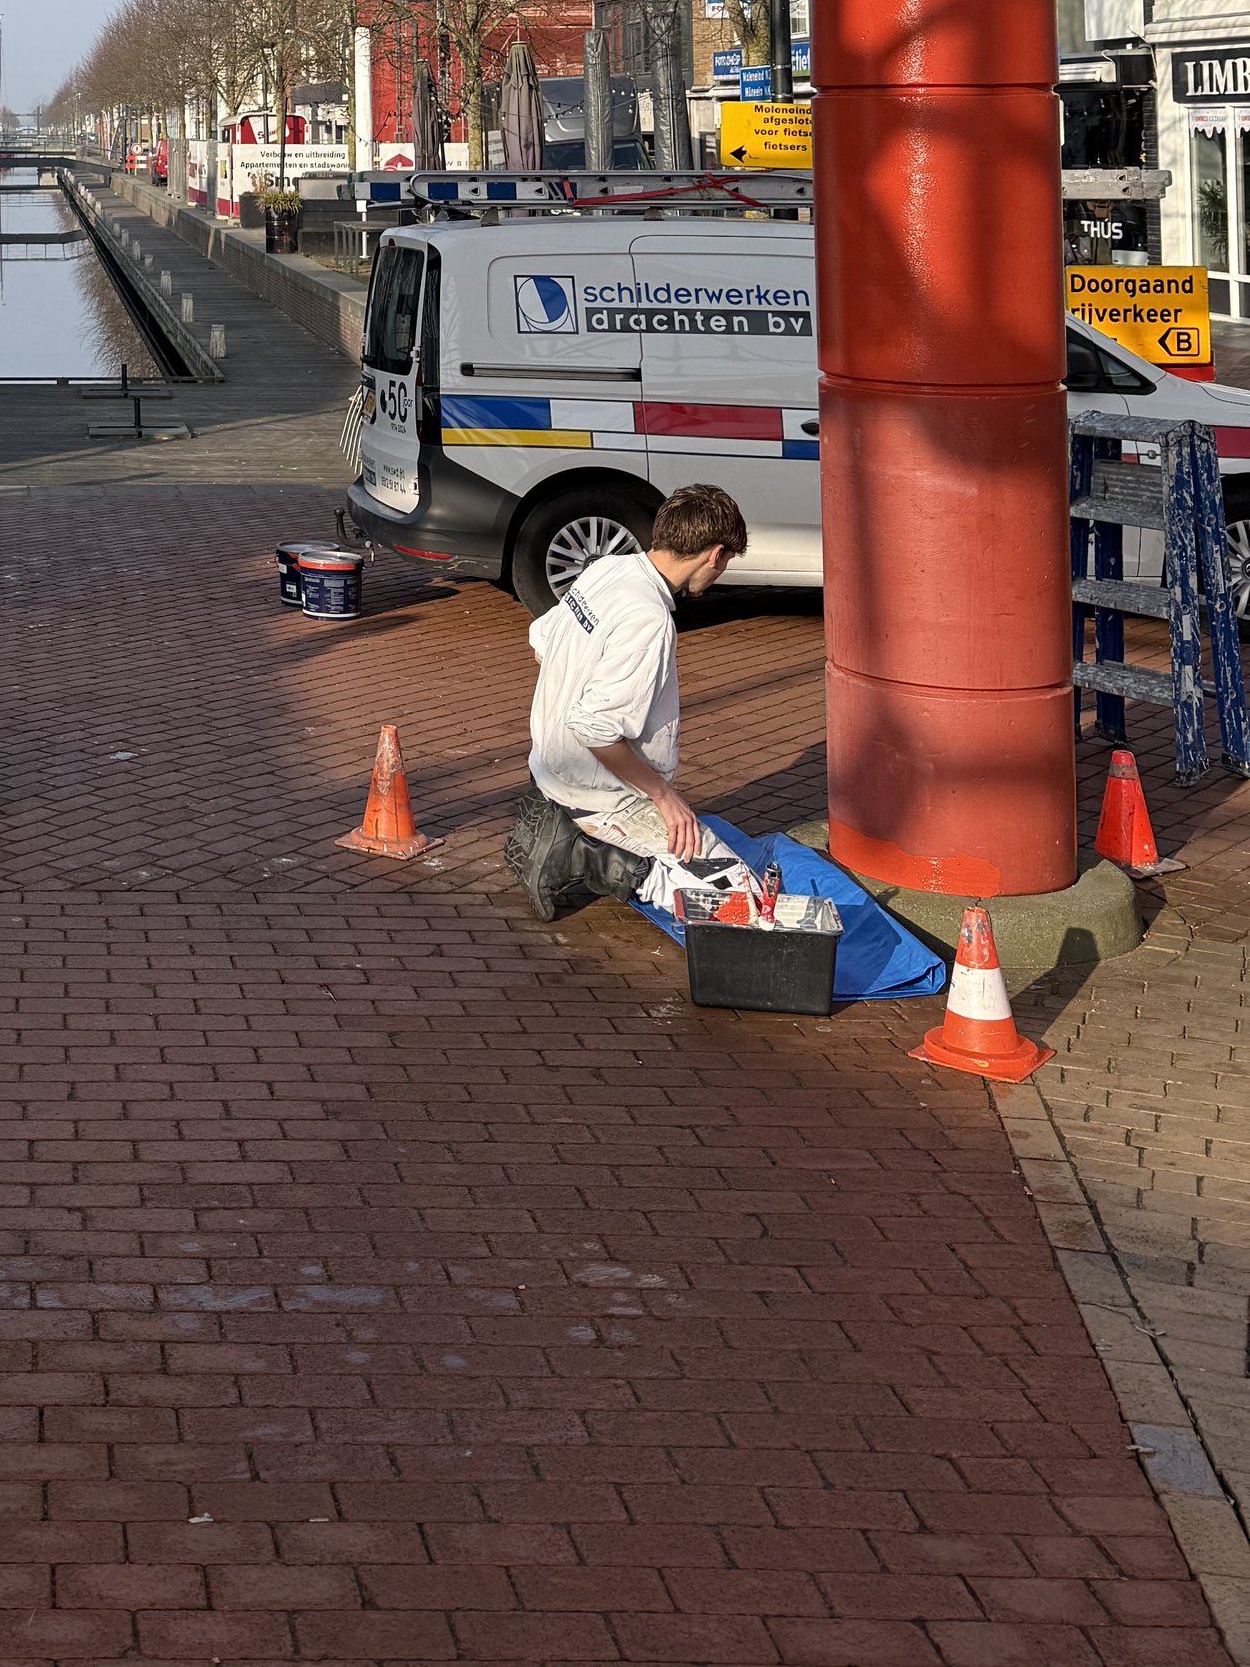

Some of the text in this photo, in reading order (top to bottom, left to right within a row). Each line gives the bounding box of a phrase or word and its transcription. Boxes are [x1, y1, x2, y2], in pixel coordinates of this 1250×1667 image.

[754, 104, 812, 115] Moleneind
[754, 128, 779, 136] voor
[260, 150, 346, 160] Verbow en uitbreiding
[764, 141, 808, 152] fietsers
[240, 161, 298, 169] Appartemeten
[1080, 217, 1124, 240] THÚS
[583, 282, 811, 307] schilderwerken
[1070, 274, 1194, 299] Doorgaand
[591, 309, 804, 334] drachten bv
[1176, 331, 1192, 352] B
[388, 379, 408, 424] 50
